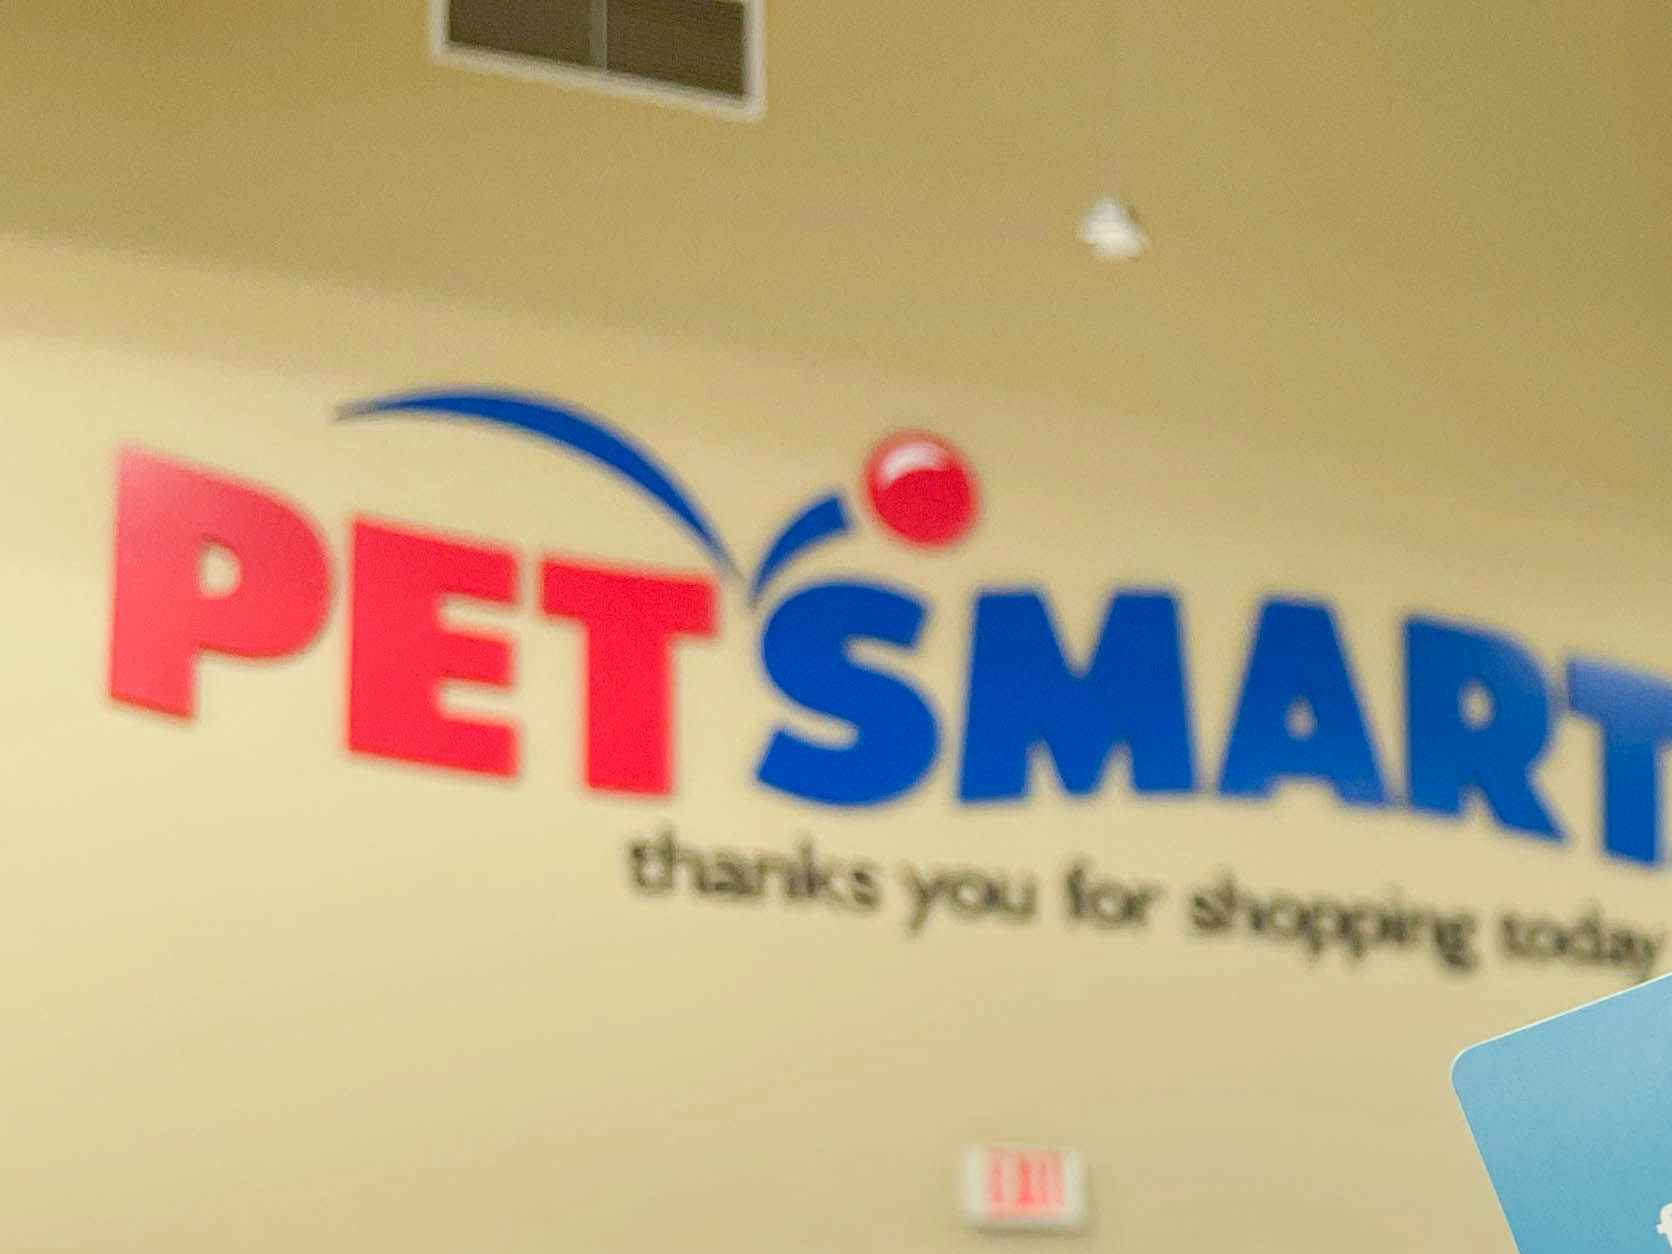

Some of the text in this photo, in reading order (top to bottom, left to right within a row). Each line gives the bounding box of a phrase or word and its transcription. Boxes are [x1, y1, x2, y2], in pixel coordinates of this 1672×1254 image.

[628, 824, 1670, 980] thanks you for shopping today
